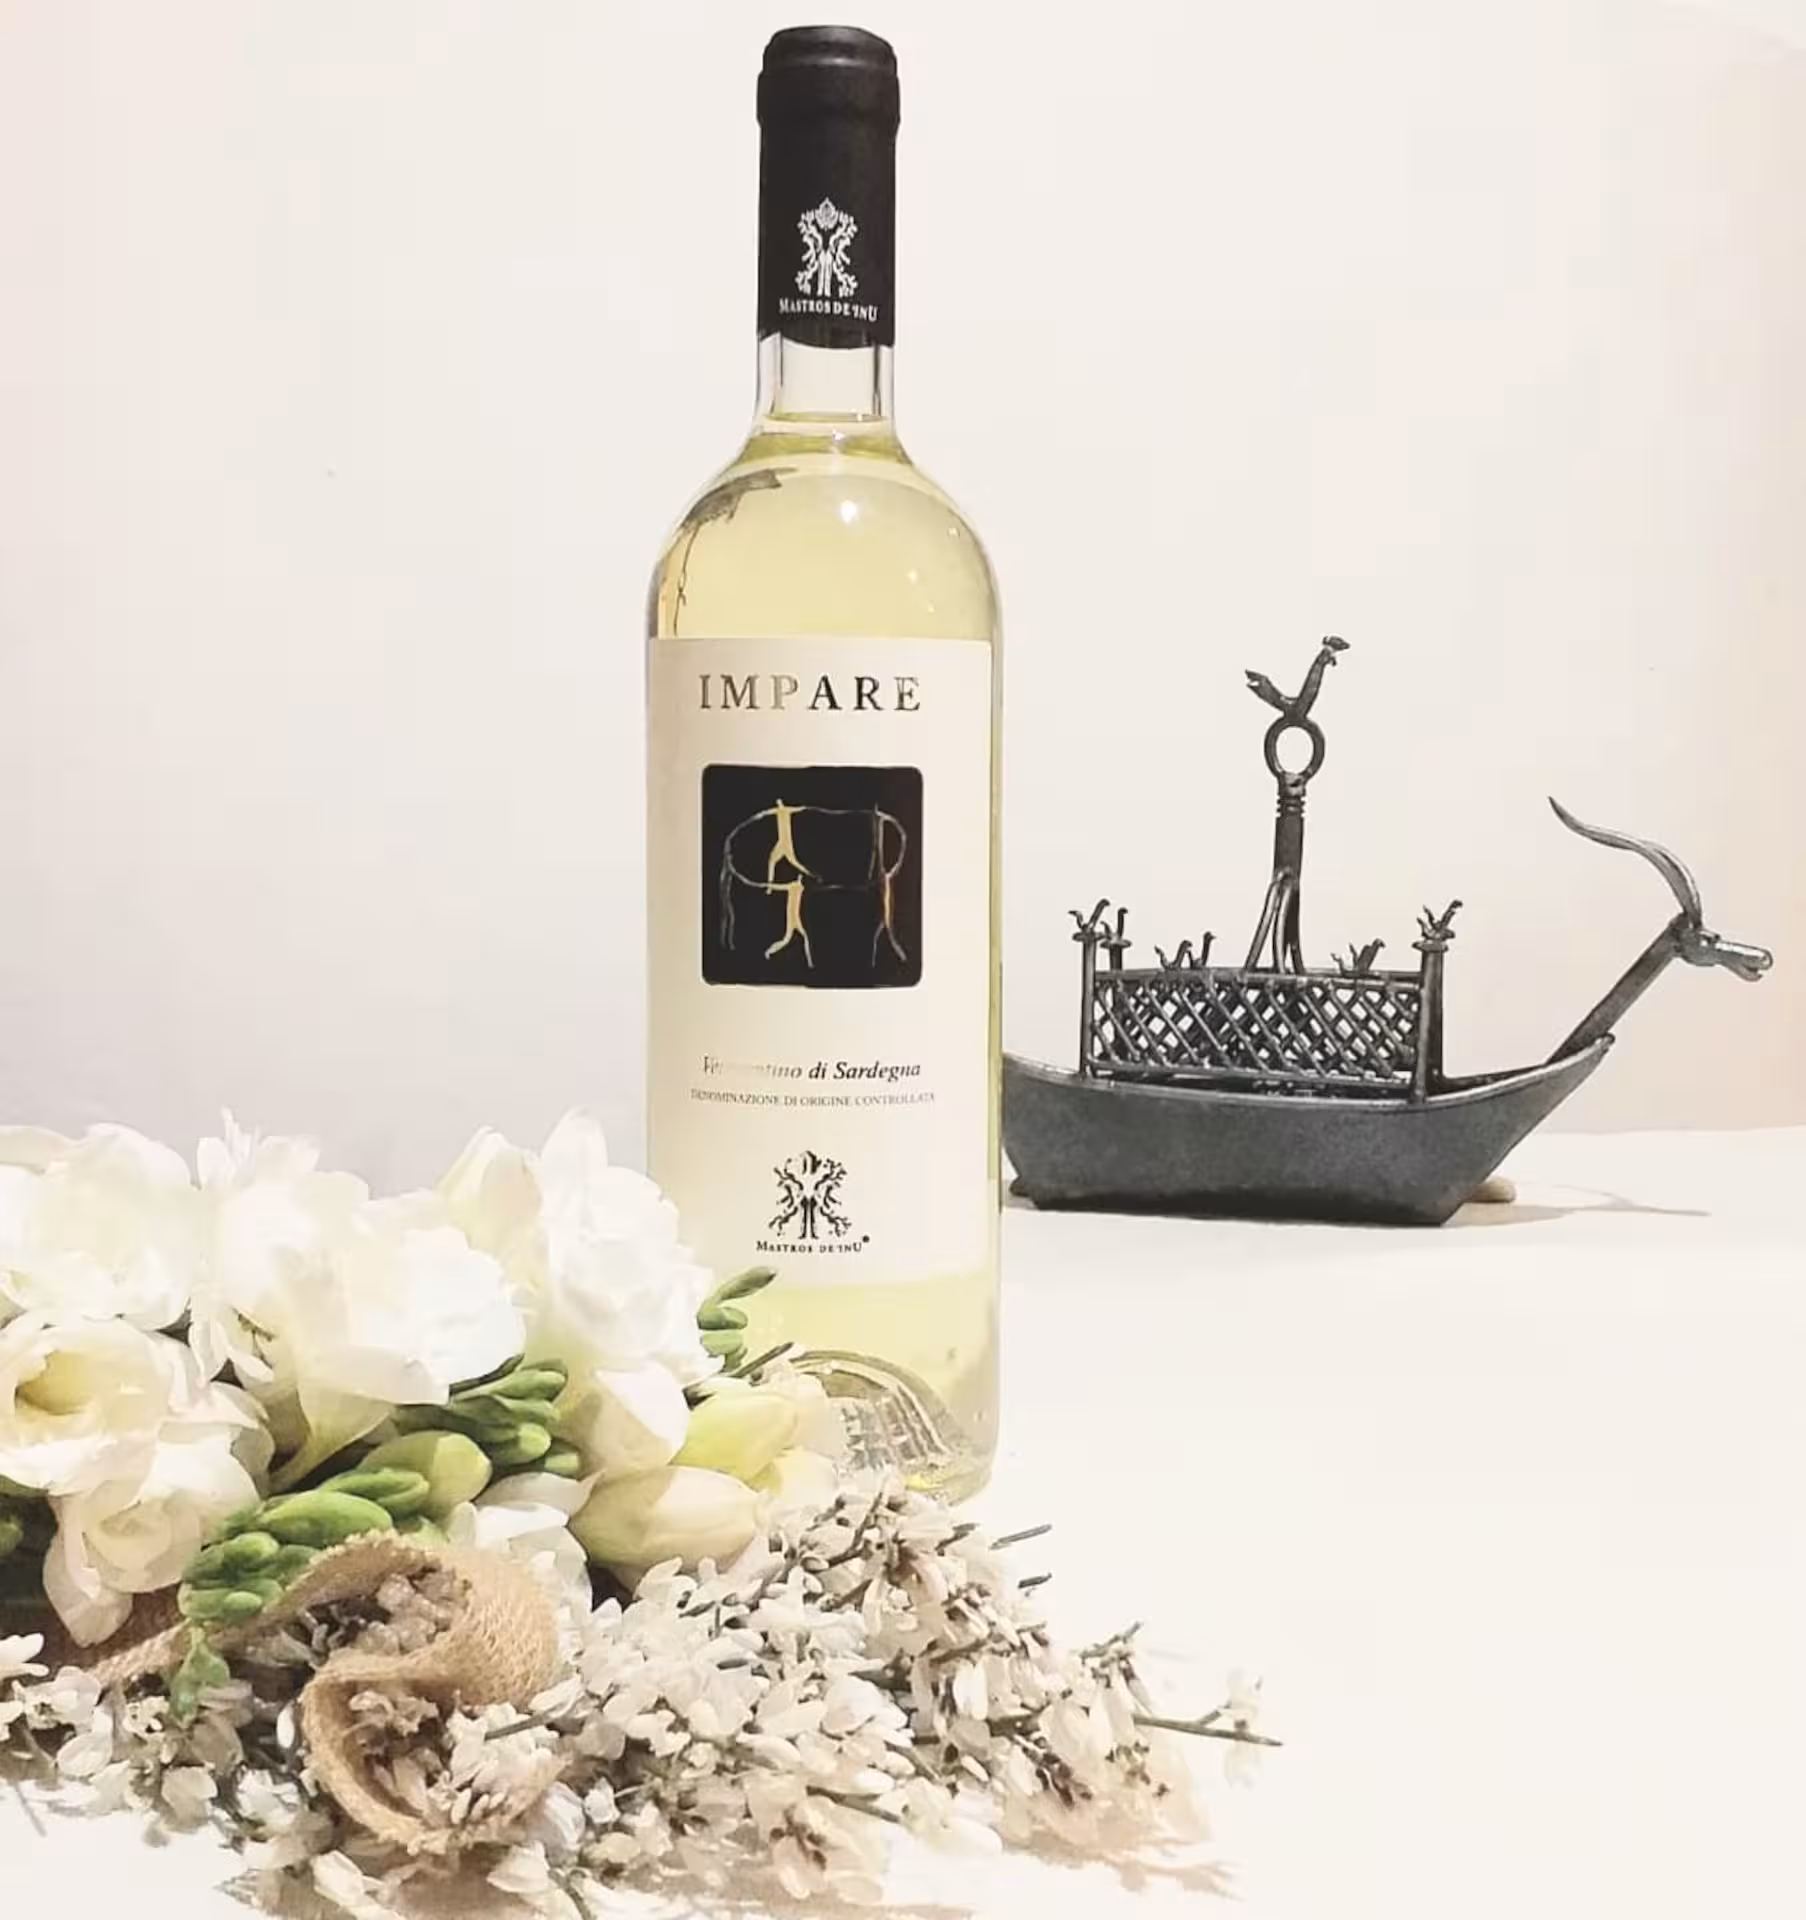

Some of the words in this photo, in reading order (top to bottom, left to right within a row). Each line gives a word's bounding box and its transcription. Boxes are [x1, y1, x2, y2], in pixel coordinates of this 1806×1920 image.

[698, 673, 921, 712] IMPARE
[808, 1060, 828, 1080] di
[833, 1060, 921, 1082] Sardegna
[783, 1095, 797, 1106] DI
[799, 1096, 850, 1107] ORIGINE
[855, 1092, 936, 1106] CONTROLLATA
